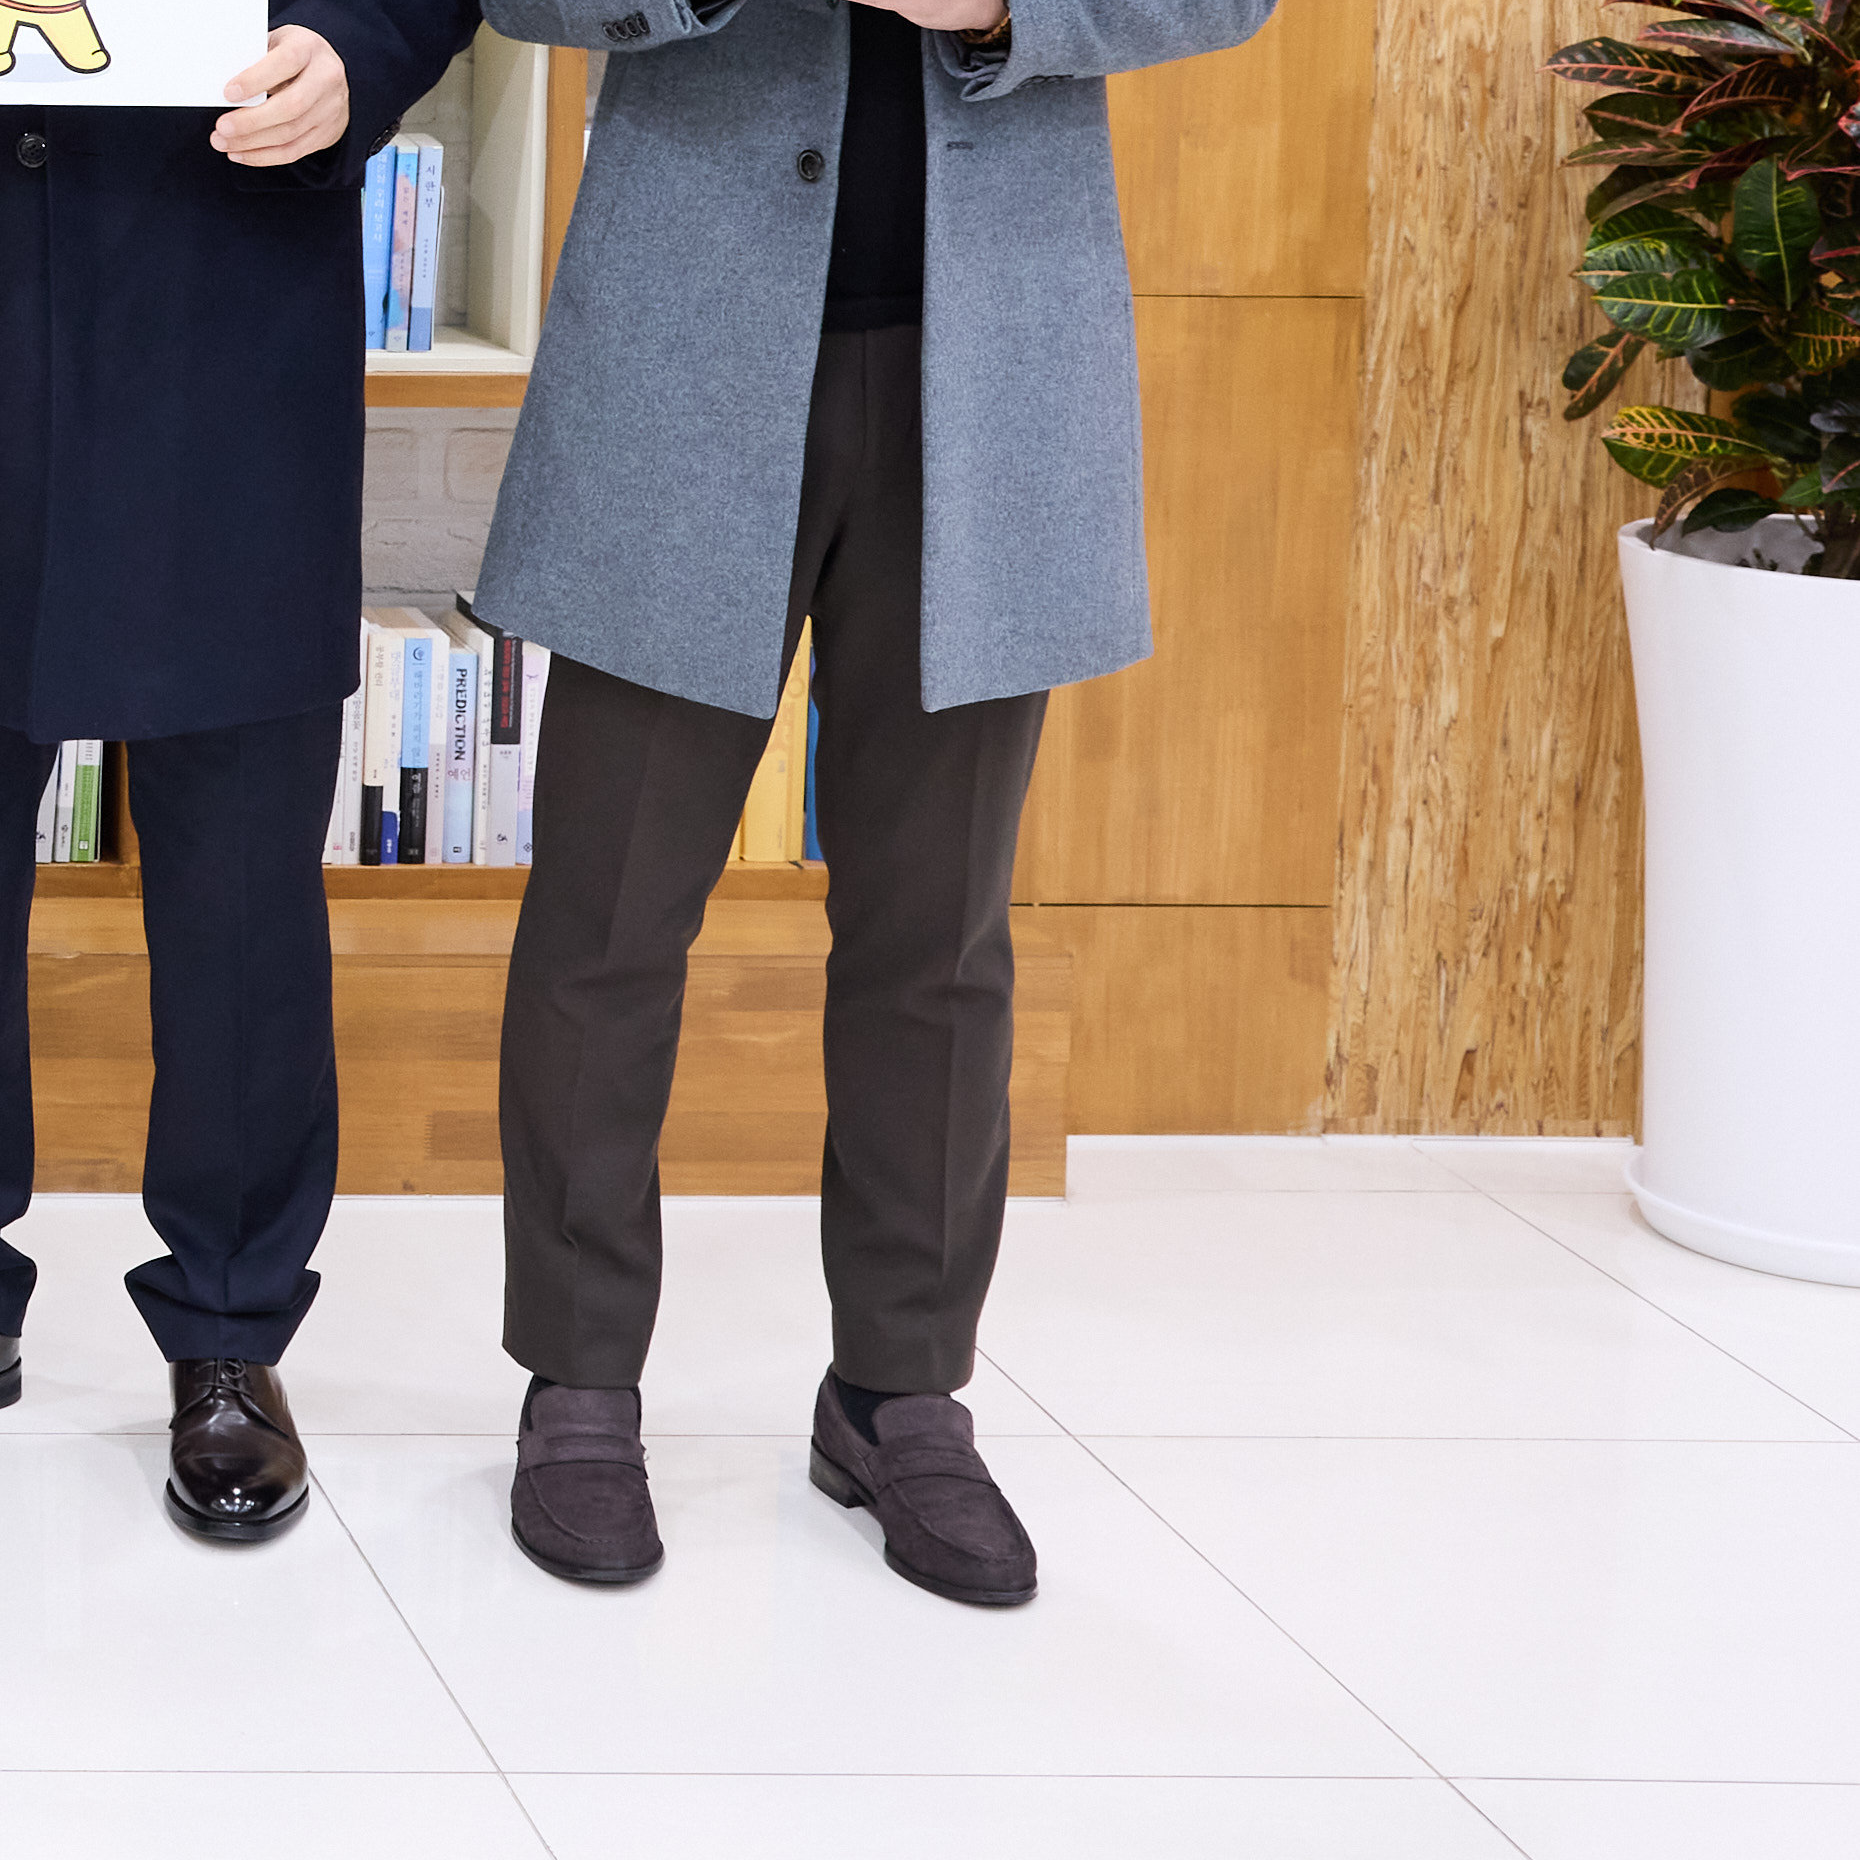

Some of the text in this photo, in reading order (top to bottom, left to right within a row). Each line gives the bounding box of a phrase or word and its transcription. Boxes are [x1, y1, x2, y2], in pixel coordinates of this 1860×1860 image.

[425, 164, 436, 208] 시한부
[453, 668, 468, 762] PREDICTION
[447, 767, 471, 782] 예언
